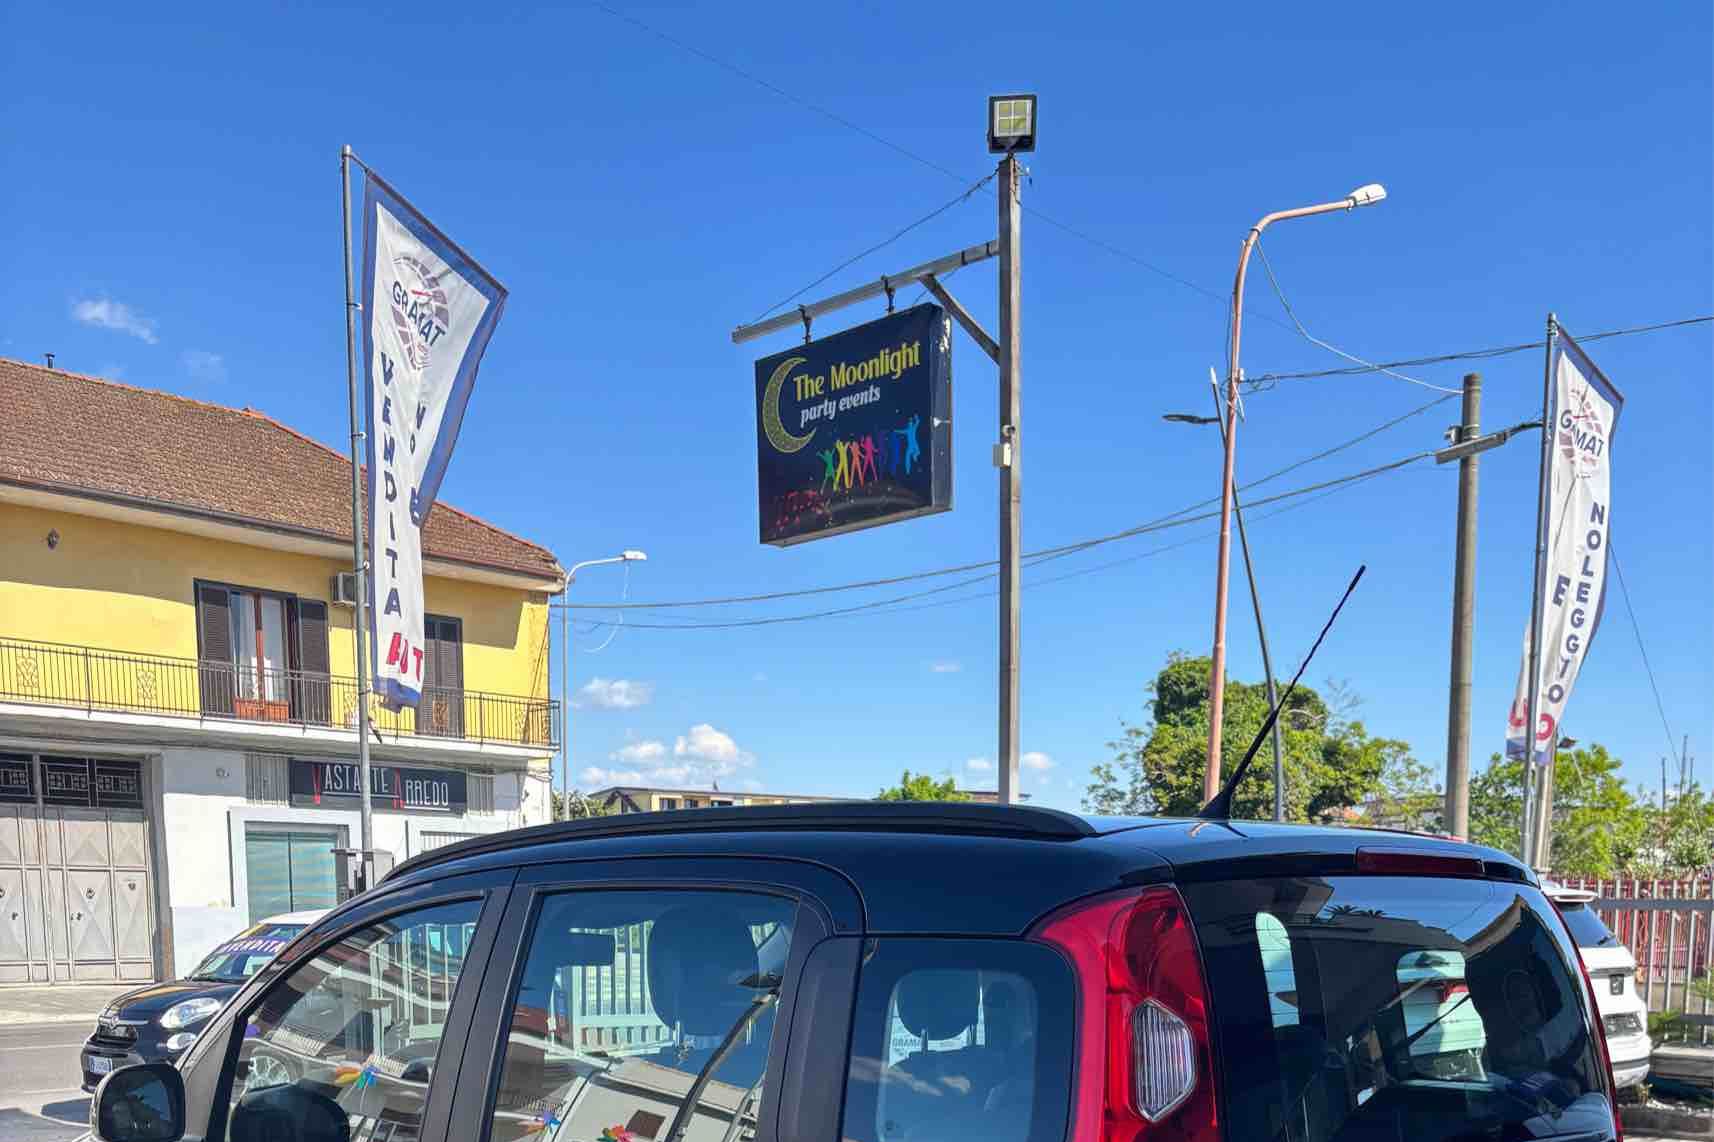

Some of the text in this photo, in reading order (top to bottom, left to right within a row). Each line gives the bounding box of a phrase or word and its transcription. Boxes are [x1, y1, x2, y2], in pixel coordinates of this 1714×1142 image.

[793, 340, 920, 401] The Moonlight
[800, 384, 881, 428] party events
[380, 352, 402, 616] VENDITA
[1548, 502, 1605, 703] NOLEGGIO
[313, 764, 449, 808] VASTATE ARREDO
